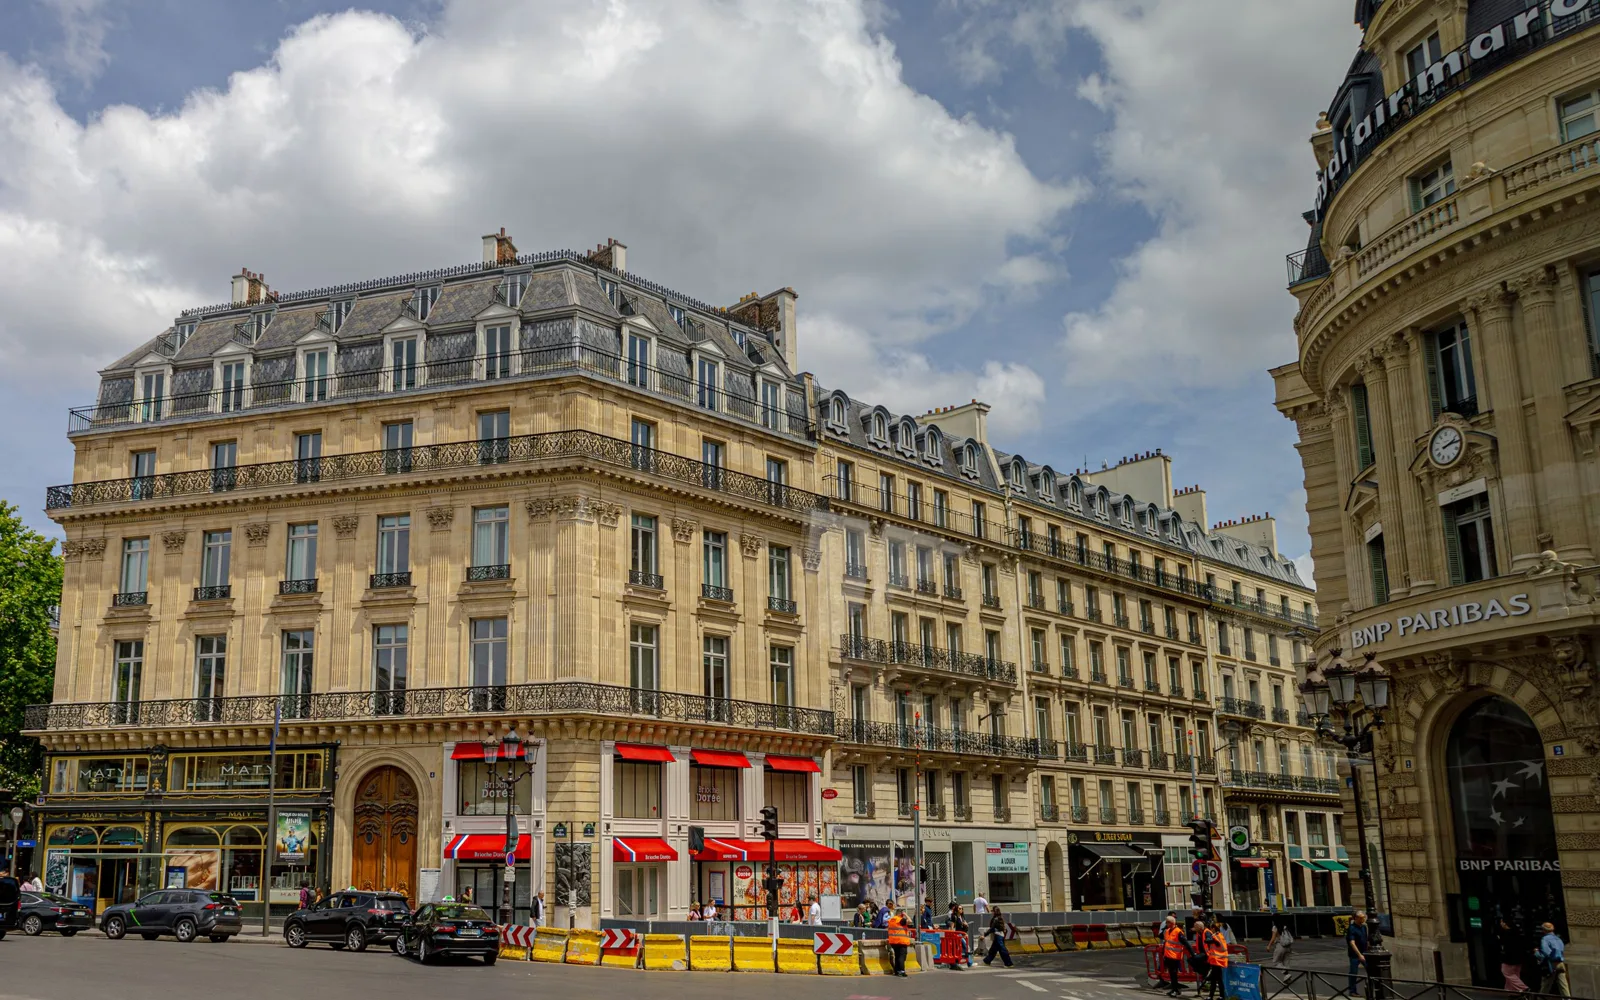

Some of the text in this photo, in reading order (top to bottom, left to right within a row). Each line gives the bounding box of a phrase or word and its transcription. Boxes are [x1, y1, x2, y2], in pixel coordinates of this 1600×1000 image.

[1354, 86, 1405, 146] air
[1352, 593, 1531, 649] BNP PARIBAS
[80, 768, 125, 778] MATY
[222, 764, 277, 775] MATY
[484, 780, 513, 789] Brioch
[698, 785, 719, 793] Brioche
[696, 792, 721, 802] Dorée
[1117, 833, 1132, 841] SUGAR
[1460, 860, 1560, 872] BNP PARIBAS
